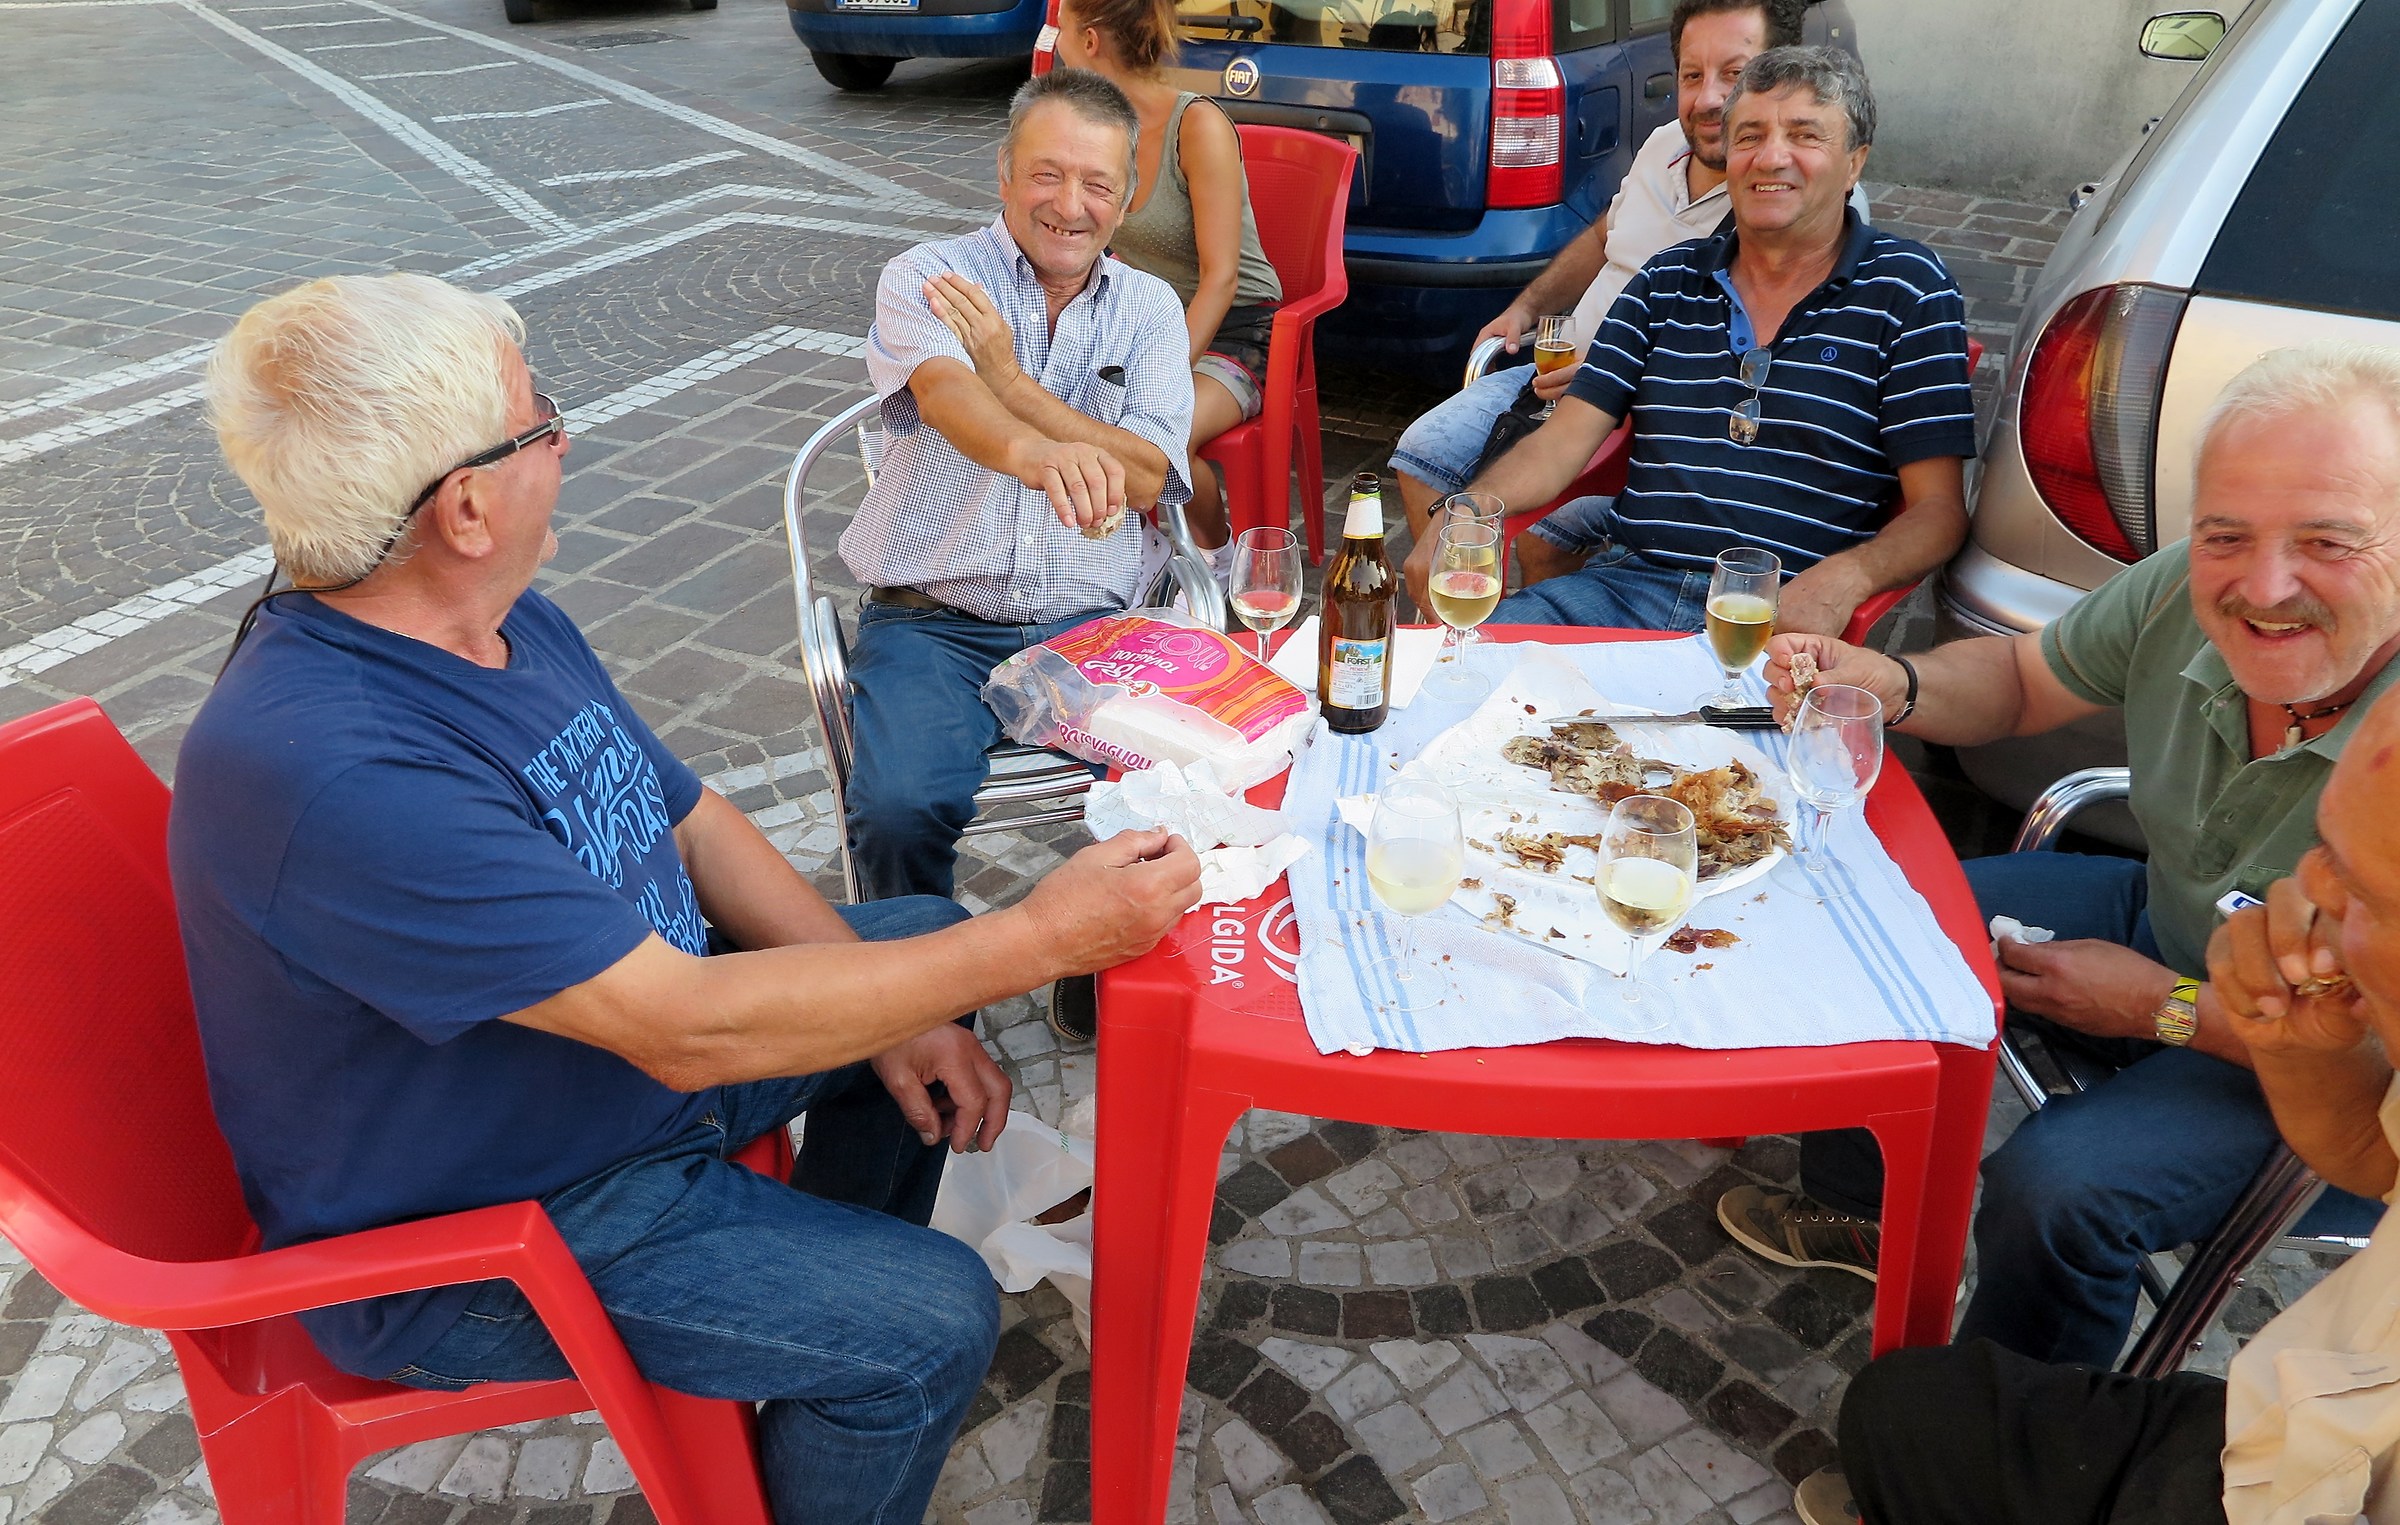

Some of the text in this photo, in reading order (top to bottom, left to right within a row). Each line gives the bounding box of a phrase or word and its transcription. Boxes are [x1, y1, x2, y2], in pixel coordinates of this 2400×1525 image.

[1229, 69, 1252, 85] FIAT
[1108, 649, 1180, 674] TOVAGLIOLI
[1347, 657, 1372, 665] FORST
[522, 749, 568, 802] THE
[610, 763, 671, 865] COAST
